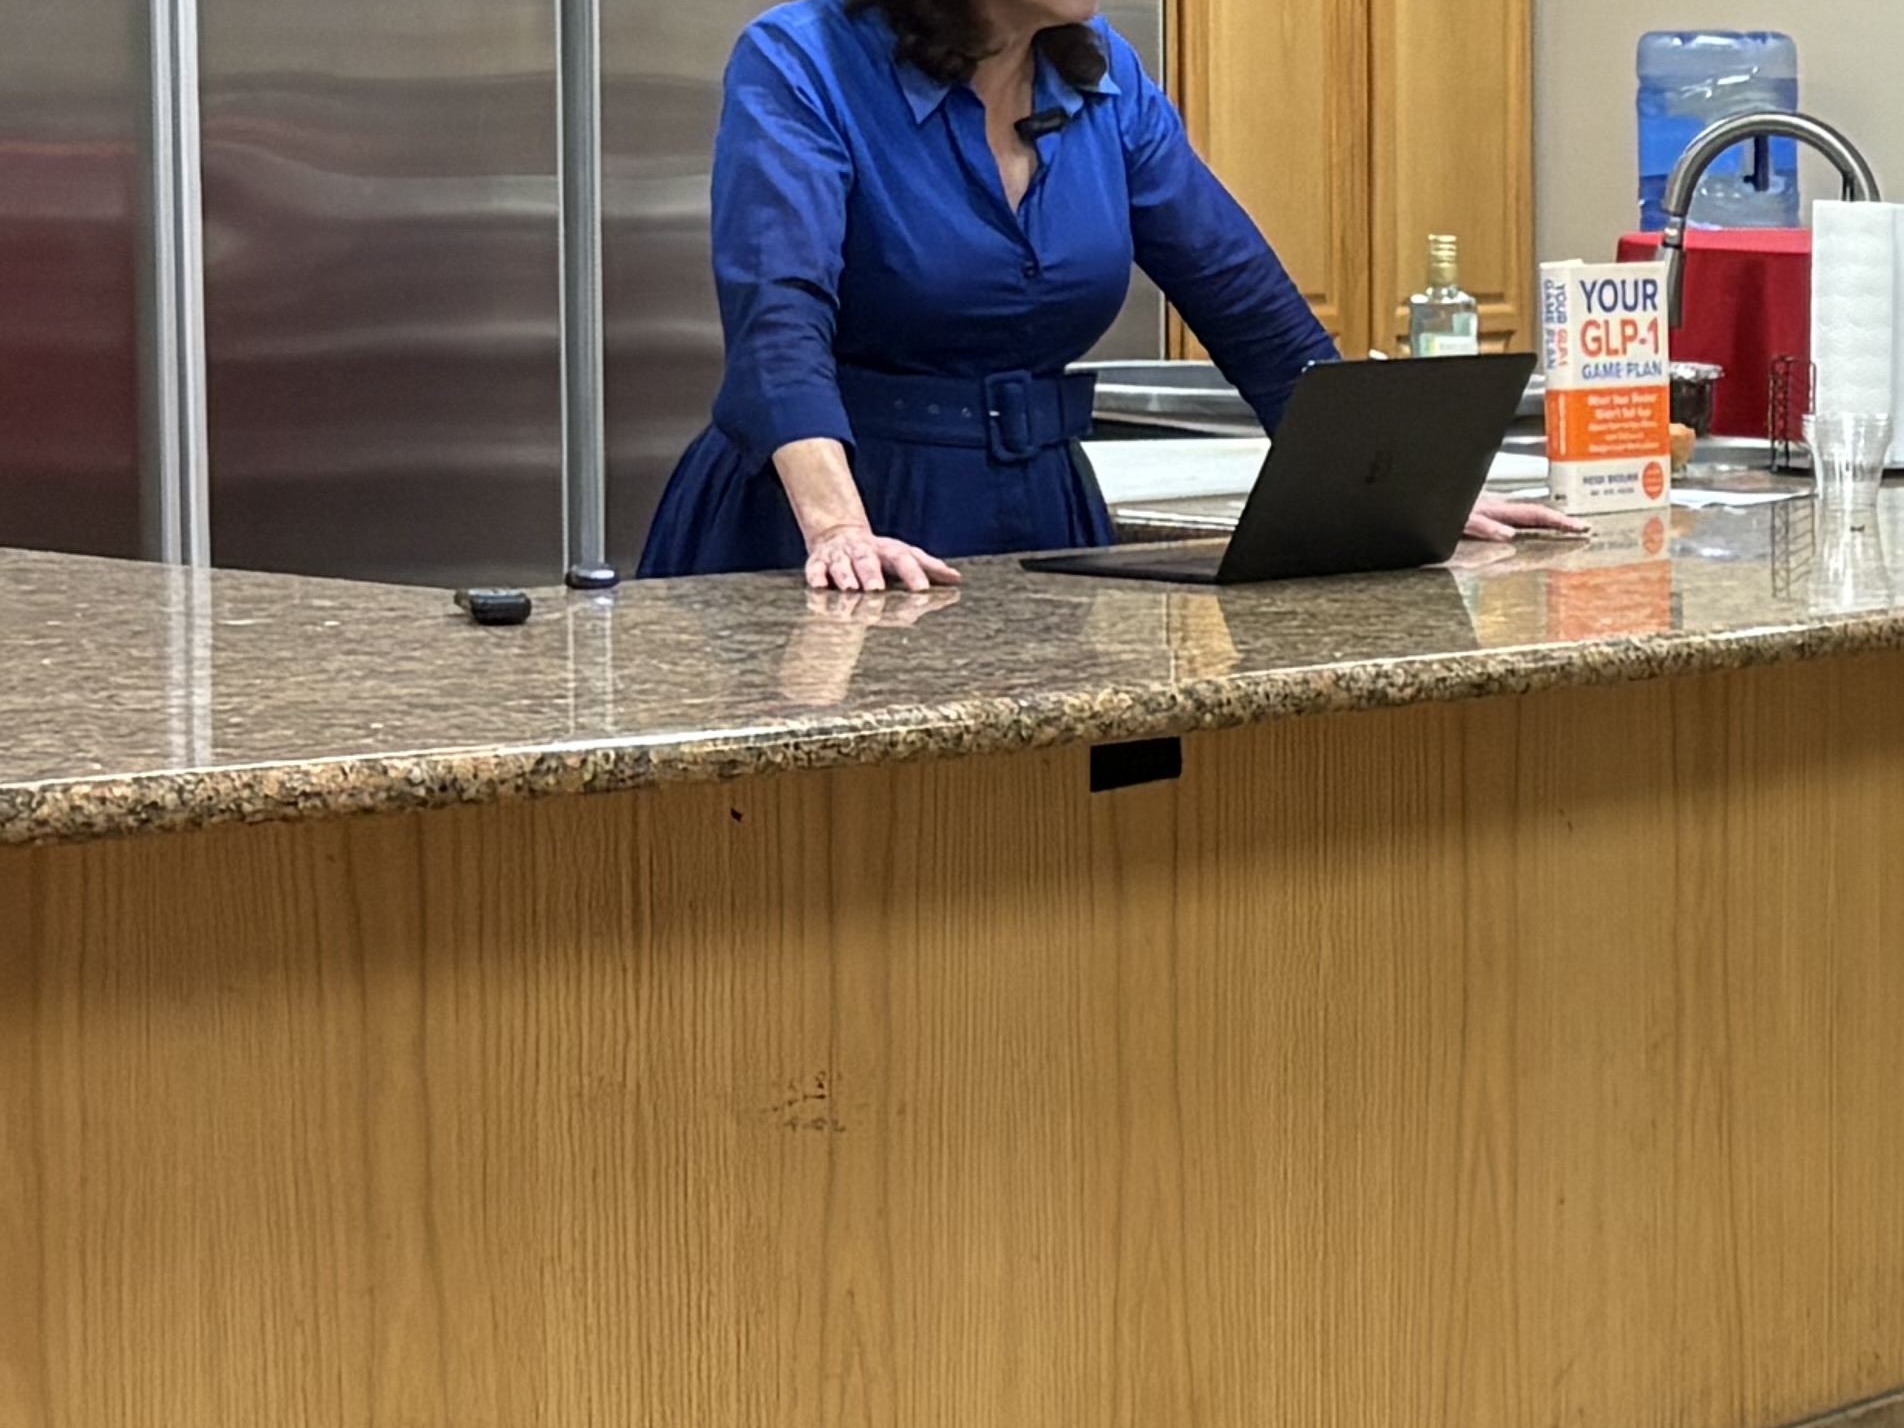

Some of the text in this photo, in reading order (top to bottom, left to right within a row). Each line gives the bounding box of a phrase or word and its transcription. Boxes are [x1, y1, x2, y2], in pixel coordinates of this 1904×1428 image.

[1579, 278, 1659, 314] YOUR
[1580, 317, 1660, 358] GLP-1
[1581, 360, 1662, 379] GAME PLAN
